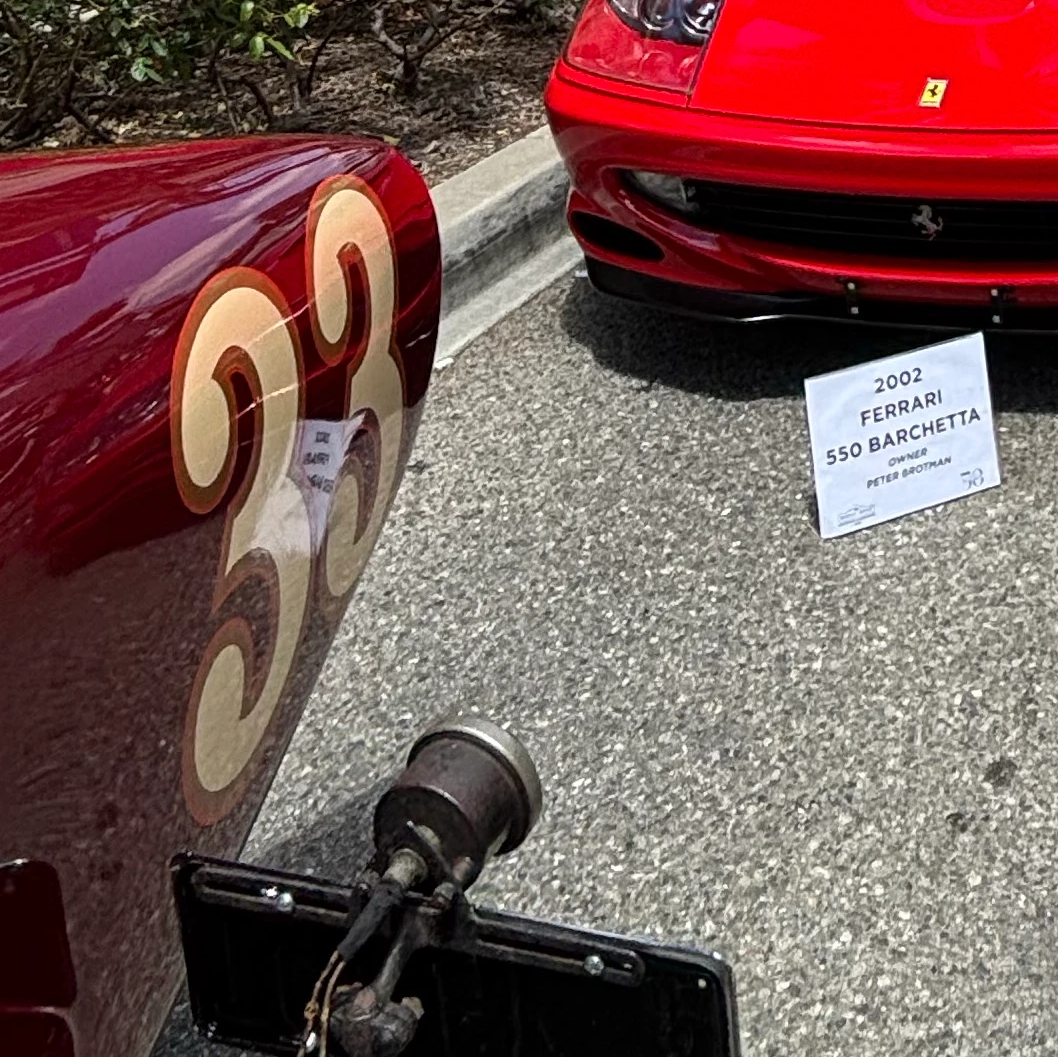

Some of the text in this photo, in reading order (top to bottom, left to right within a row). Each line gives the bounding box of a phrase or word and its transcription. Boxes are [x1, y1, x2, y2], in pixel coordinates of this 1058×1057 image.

[874, 367, 923, 394] 2002
[860, 389, 943, 427] FERRARI
[826, 408, 981, 466] 550 BARCHETTA
[866, 456, 952, 489] PETER BROTMAN
[888, 448, 928, 467] OWNER
